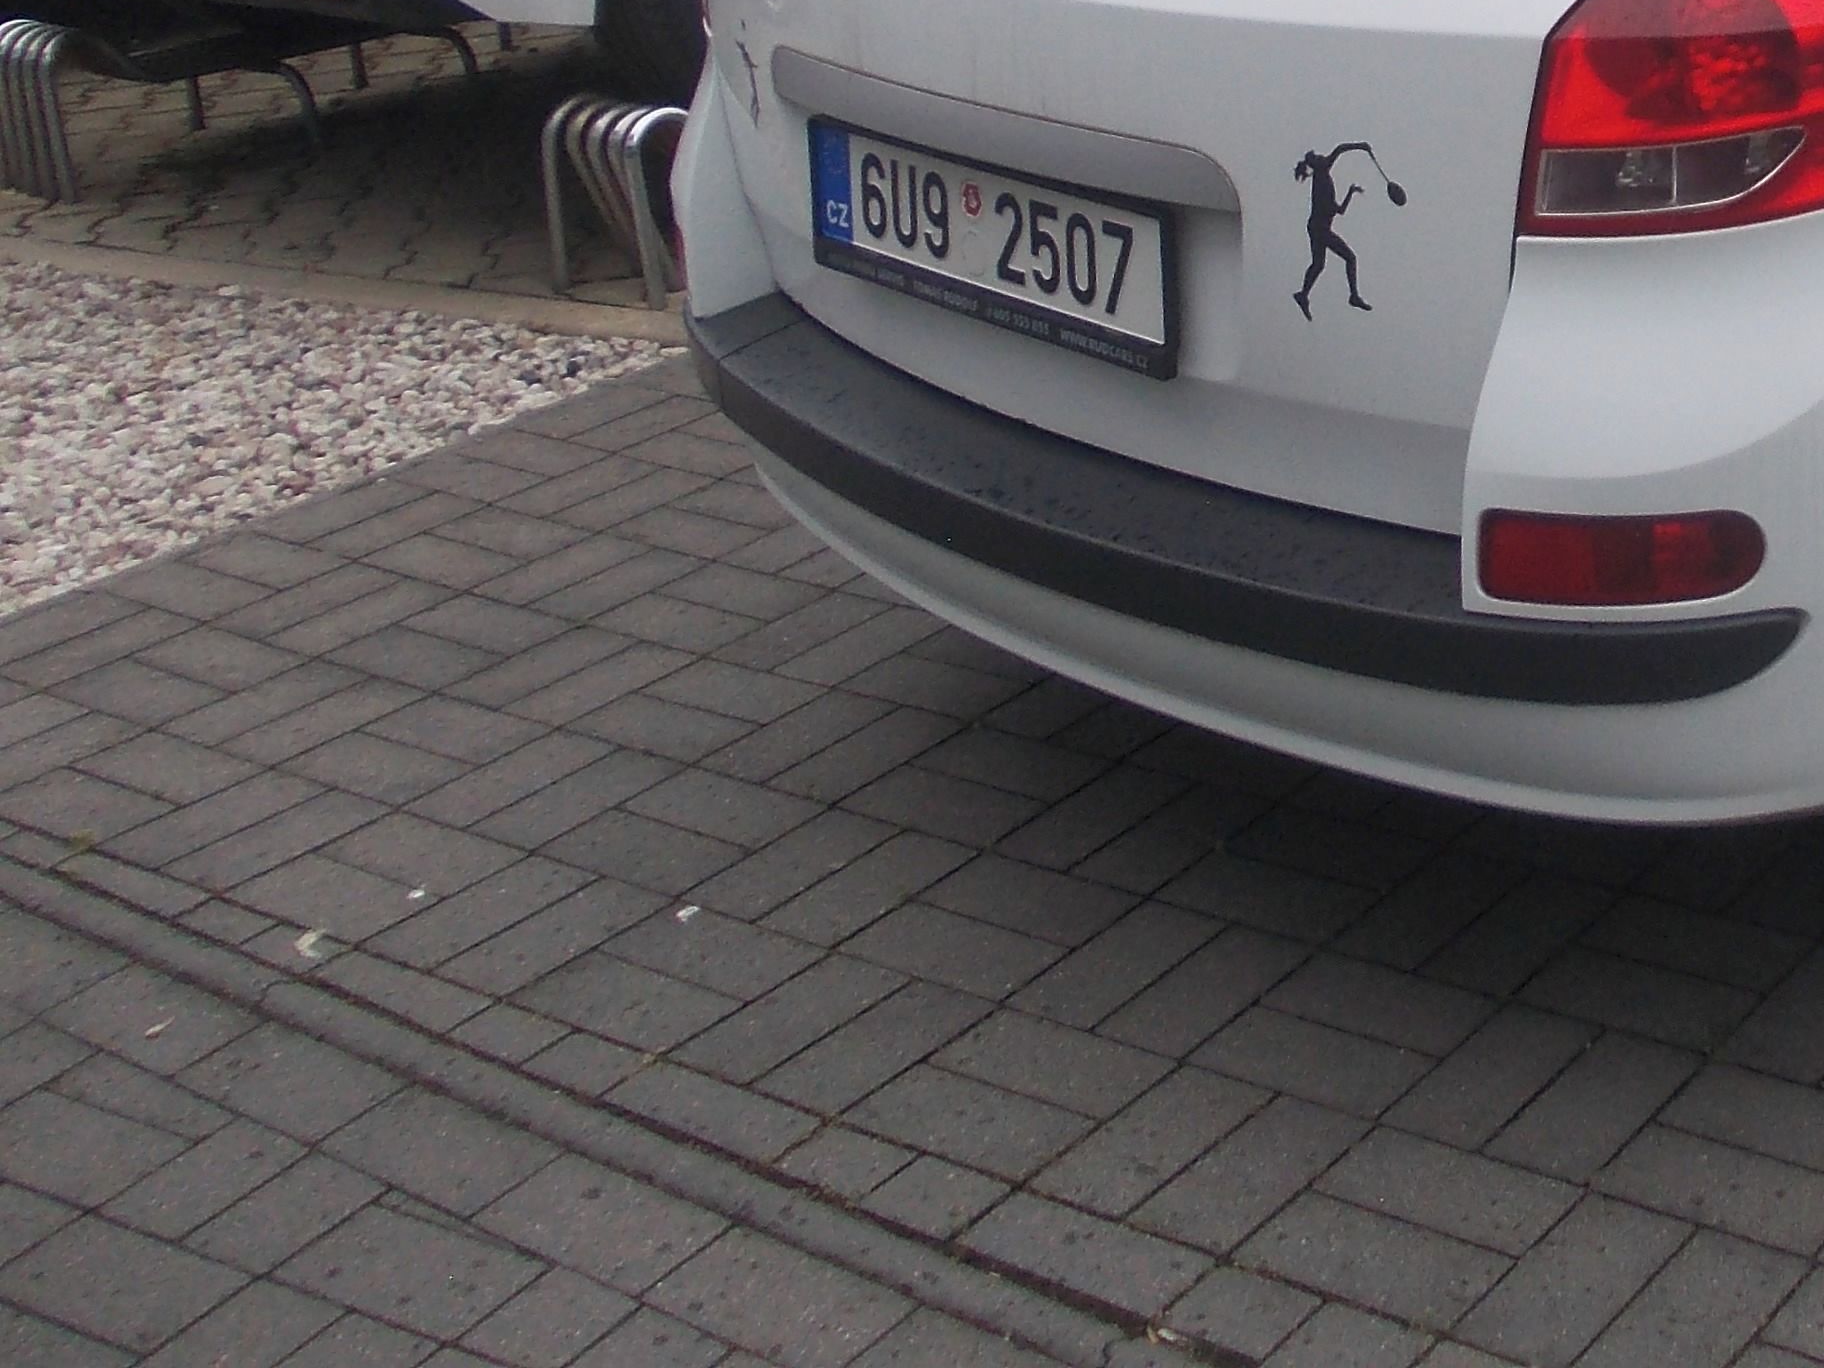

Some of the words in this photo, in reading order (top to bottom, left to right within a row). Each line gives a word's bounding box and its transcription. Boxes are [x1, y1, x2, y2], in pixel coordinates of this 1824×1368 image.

[826, 199, 850, 229] CZ
[860, 151, 950, 259] 6U9
[994, 190, 1134, 316] 2507
